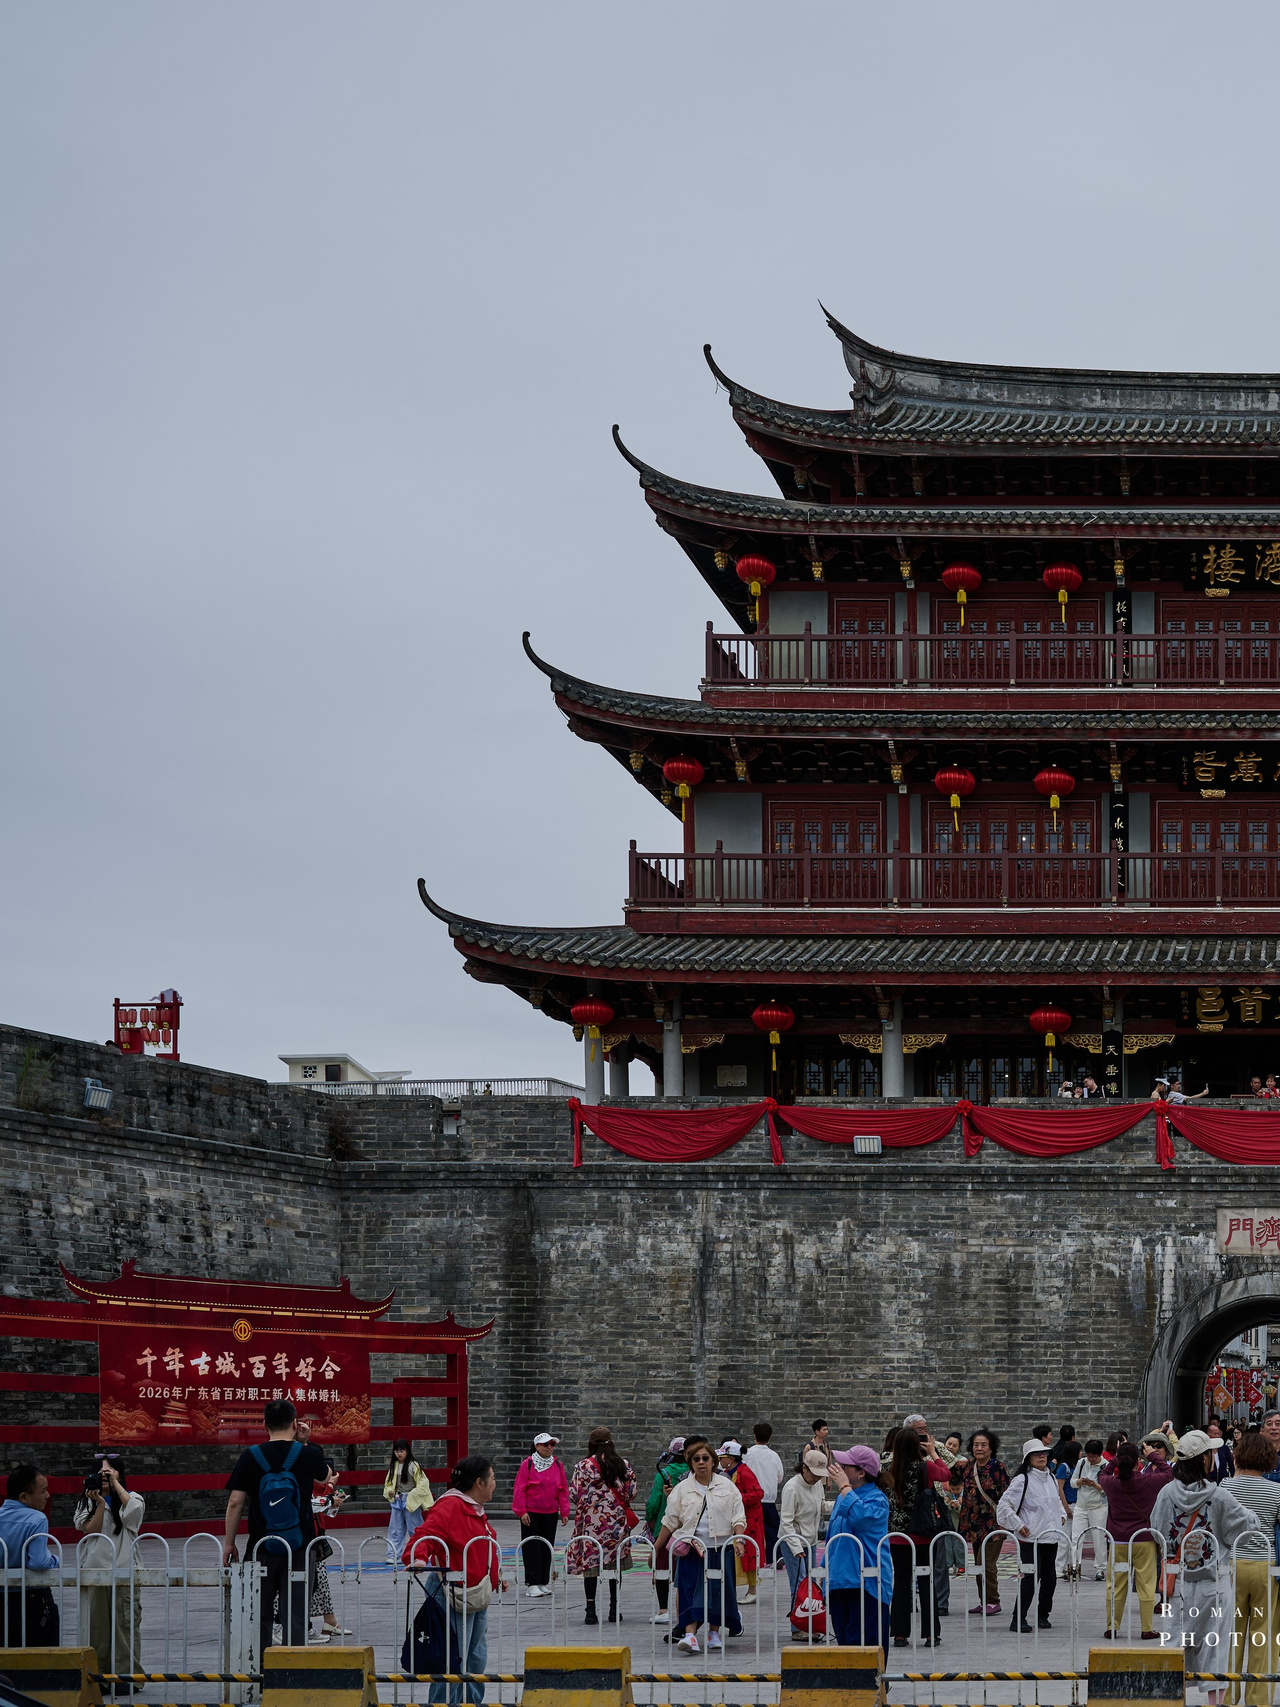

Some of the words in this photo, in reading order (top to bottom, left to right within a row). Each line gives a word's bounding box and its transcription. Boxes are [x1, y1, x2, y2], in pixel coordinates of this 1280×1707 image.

[138, 1386, 341, 1402] 2026年广东省百对职工新人集体婚礼
